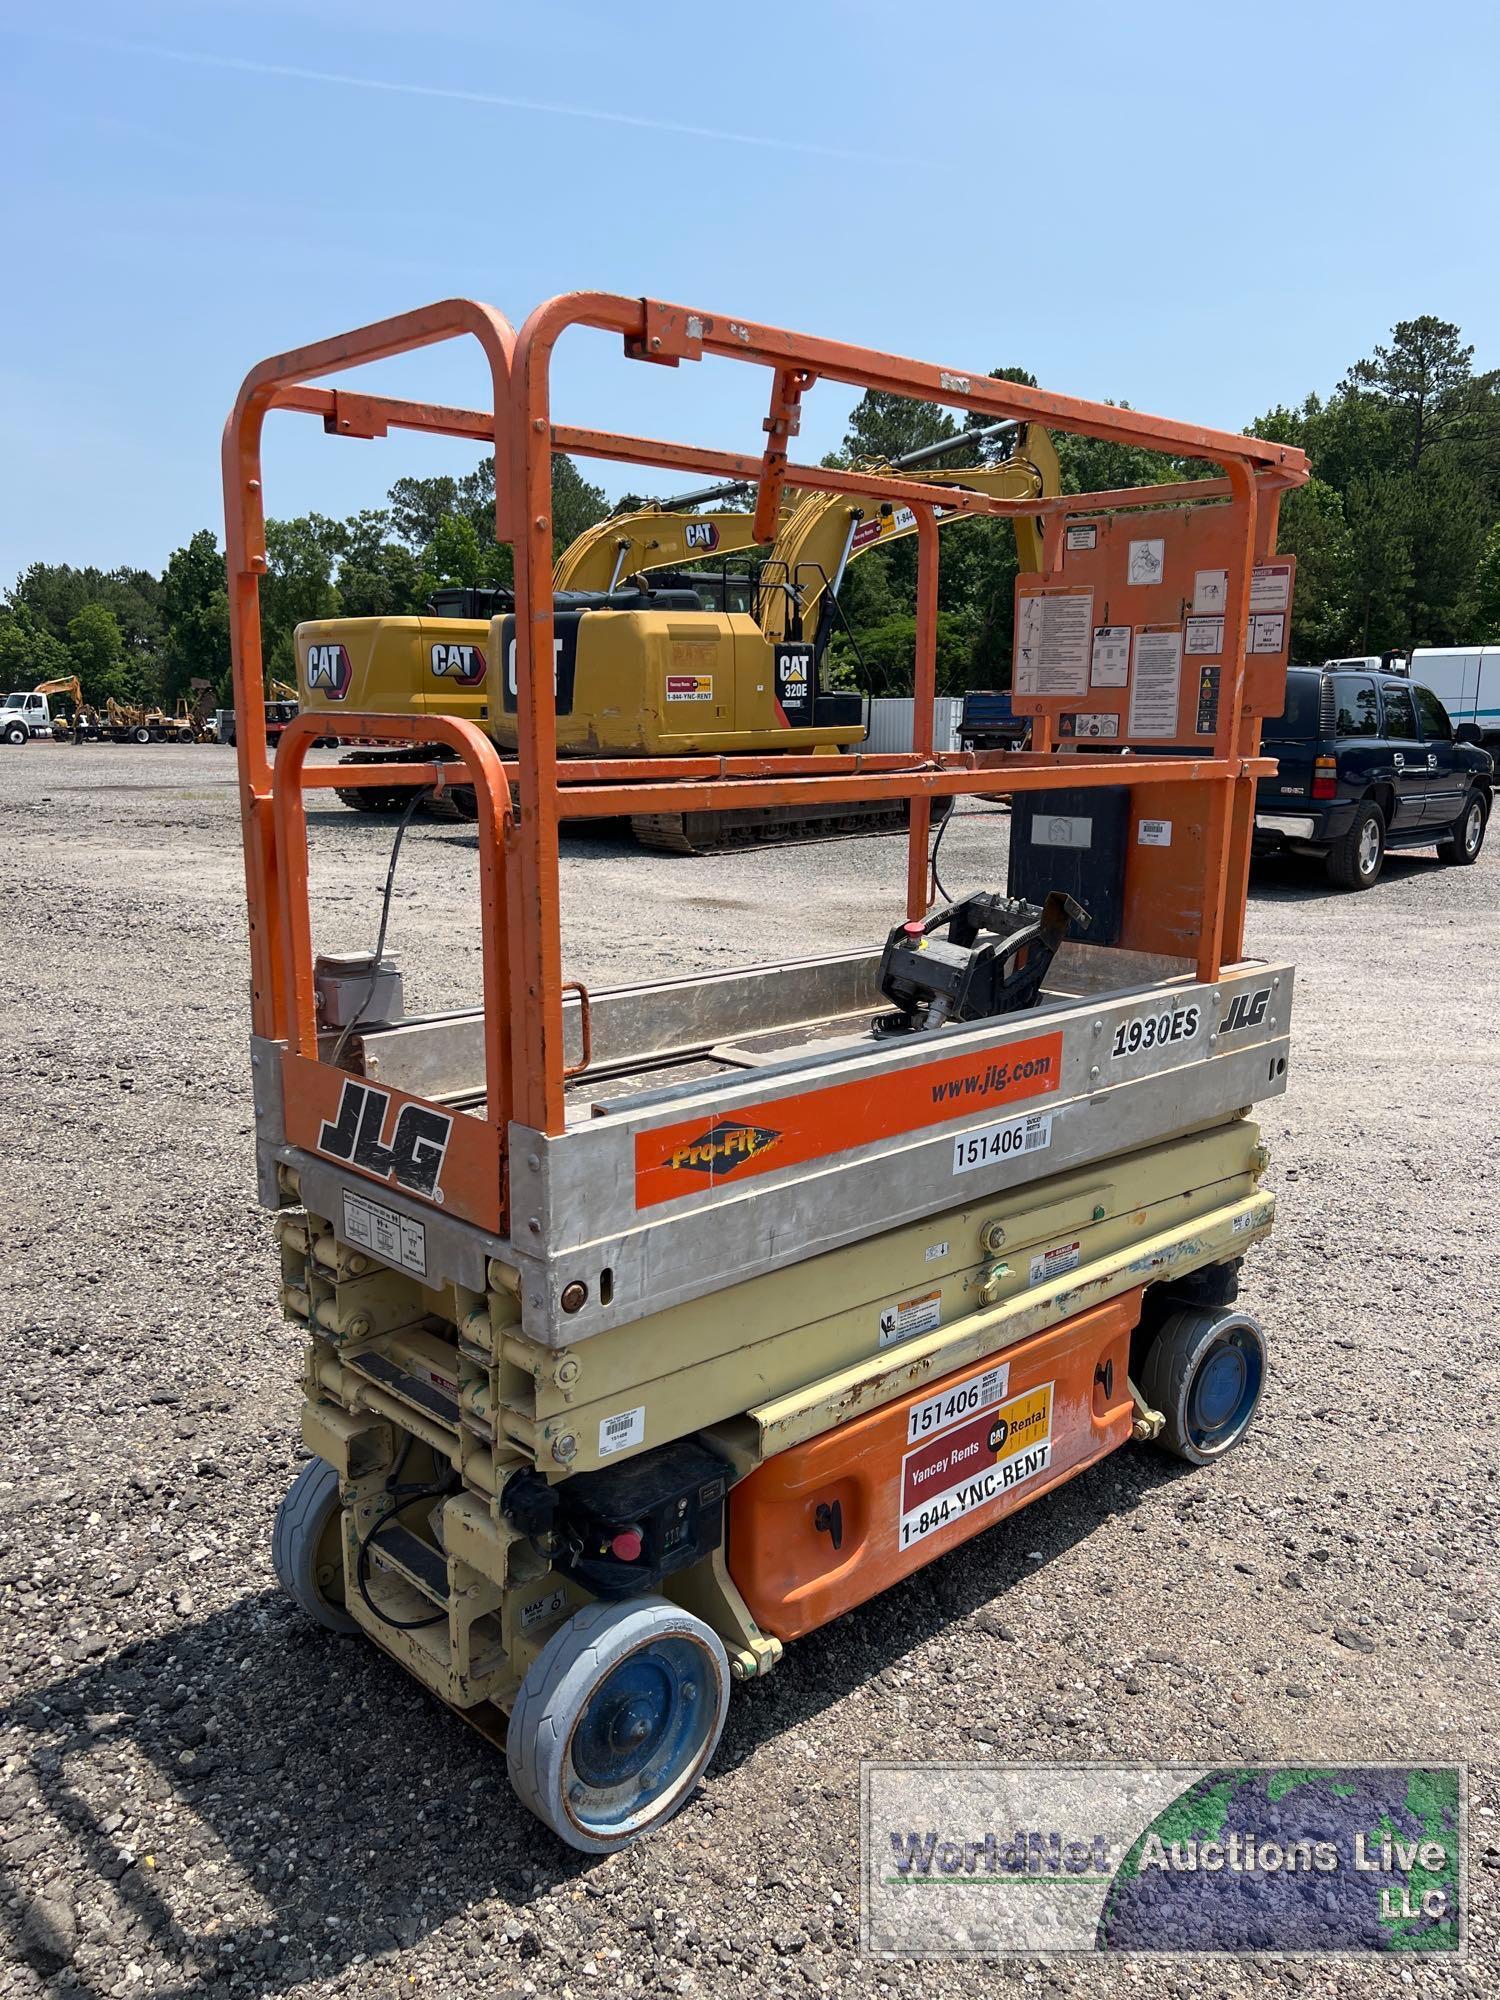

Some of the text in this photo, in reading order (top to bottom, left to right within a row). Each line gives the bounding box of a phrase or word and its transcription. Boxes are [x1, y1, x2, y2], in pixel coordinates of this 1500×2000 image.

[686, 522, 712, 548] CAT
[308, 645, 340, 688] CAT
[432, 644, 473, 676] CAT
[780, 655, 809, 682] CAT
[785, 684, 808, 697] 320E
[1112, 1005, 1201, 1058] 1930ES
[1218, 988, 1272, 1035] JLG
[932, 1057, 1052, 1103] www.jlg.com
[318, 1078, 454, 1200] JLG
[672, 1128, 757, 1170] Pro-Fit
[957, 1126, 1023, 1166] 151406
[911, 1384, 979, 1436] 151406
[1010, 1406, 1046, 1436] Rental
[990, 1426, 1006, 1446] CAT
[912, 1441, 979, 1486] Yancey Rents
[902, 1446, 1049, 1544] 1-844-YNC-RENT
[525, 1600, 544, 1615] MAX
